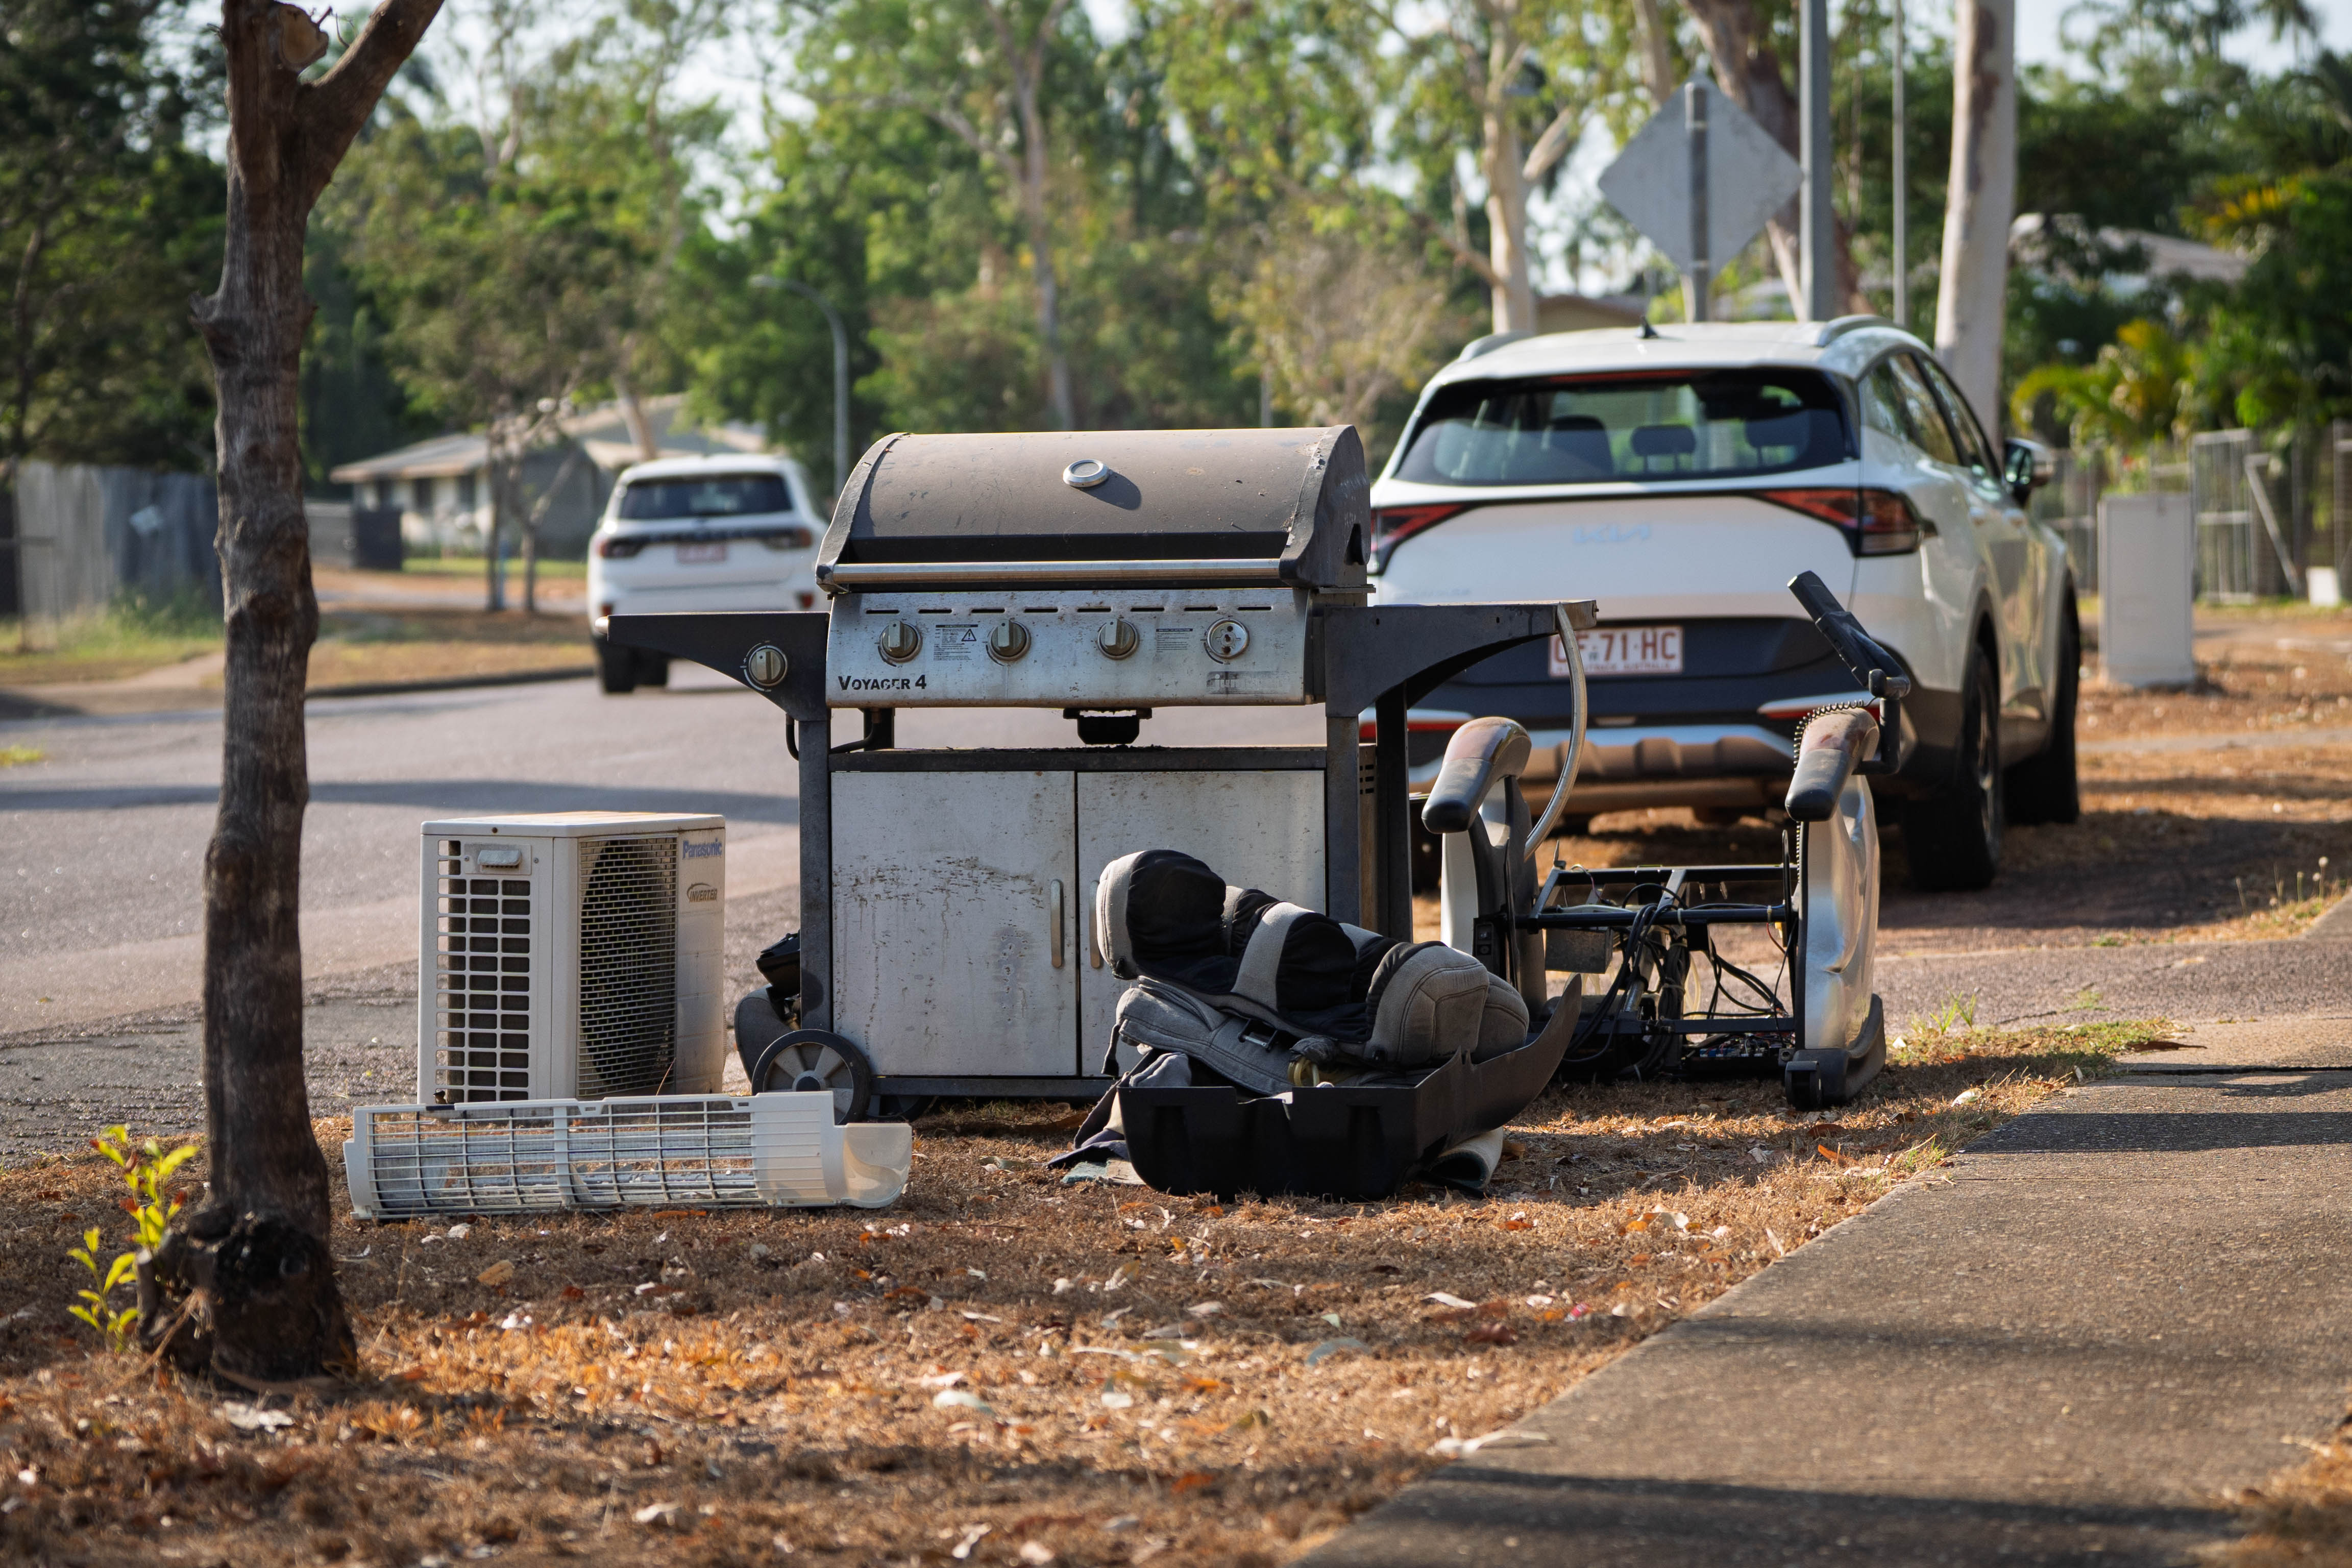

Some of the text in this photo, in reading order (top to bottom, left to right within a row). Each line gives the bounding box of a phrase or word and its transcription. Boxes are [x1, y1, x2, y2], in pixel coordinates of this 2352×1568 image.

[1575, 523, 1650, 543] KIA
[838, 674, 927, 690] VOYAGER 4
[682, 837, 722, 859] Panasonic
[690, 889, 718, 902] INVERTER
